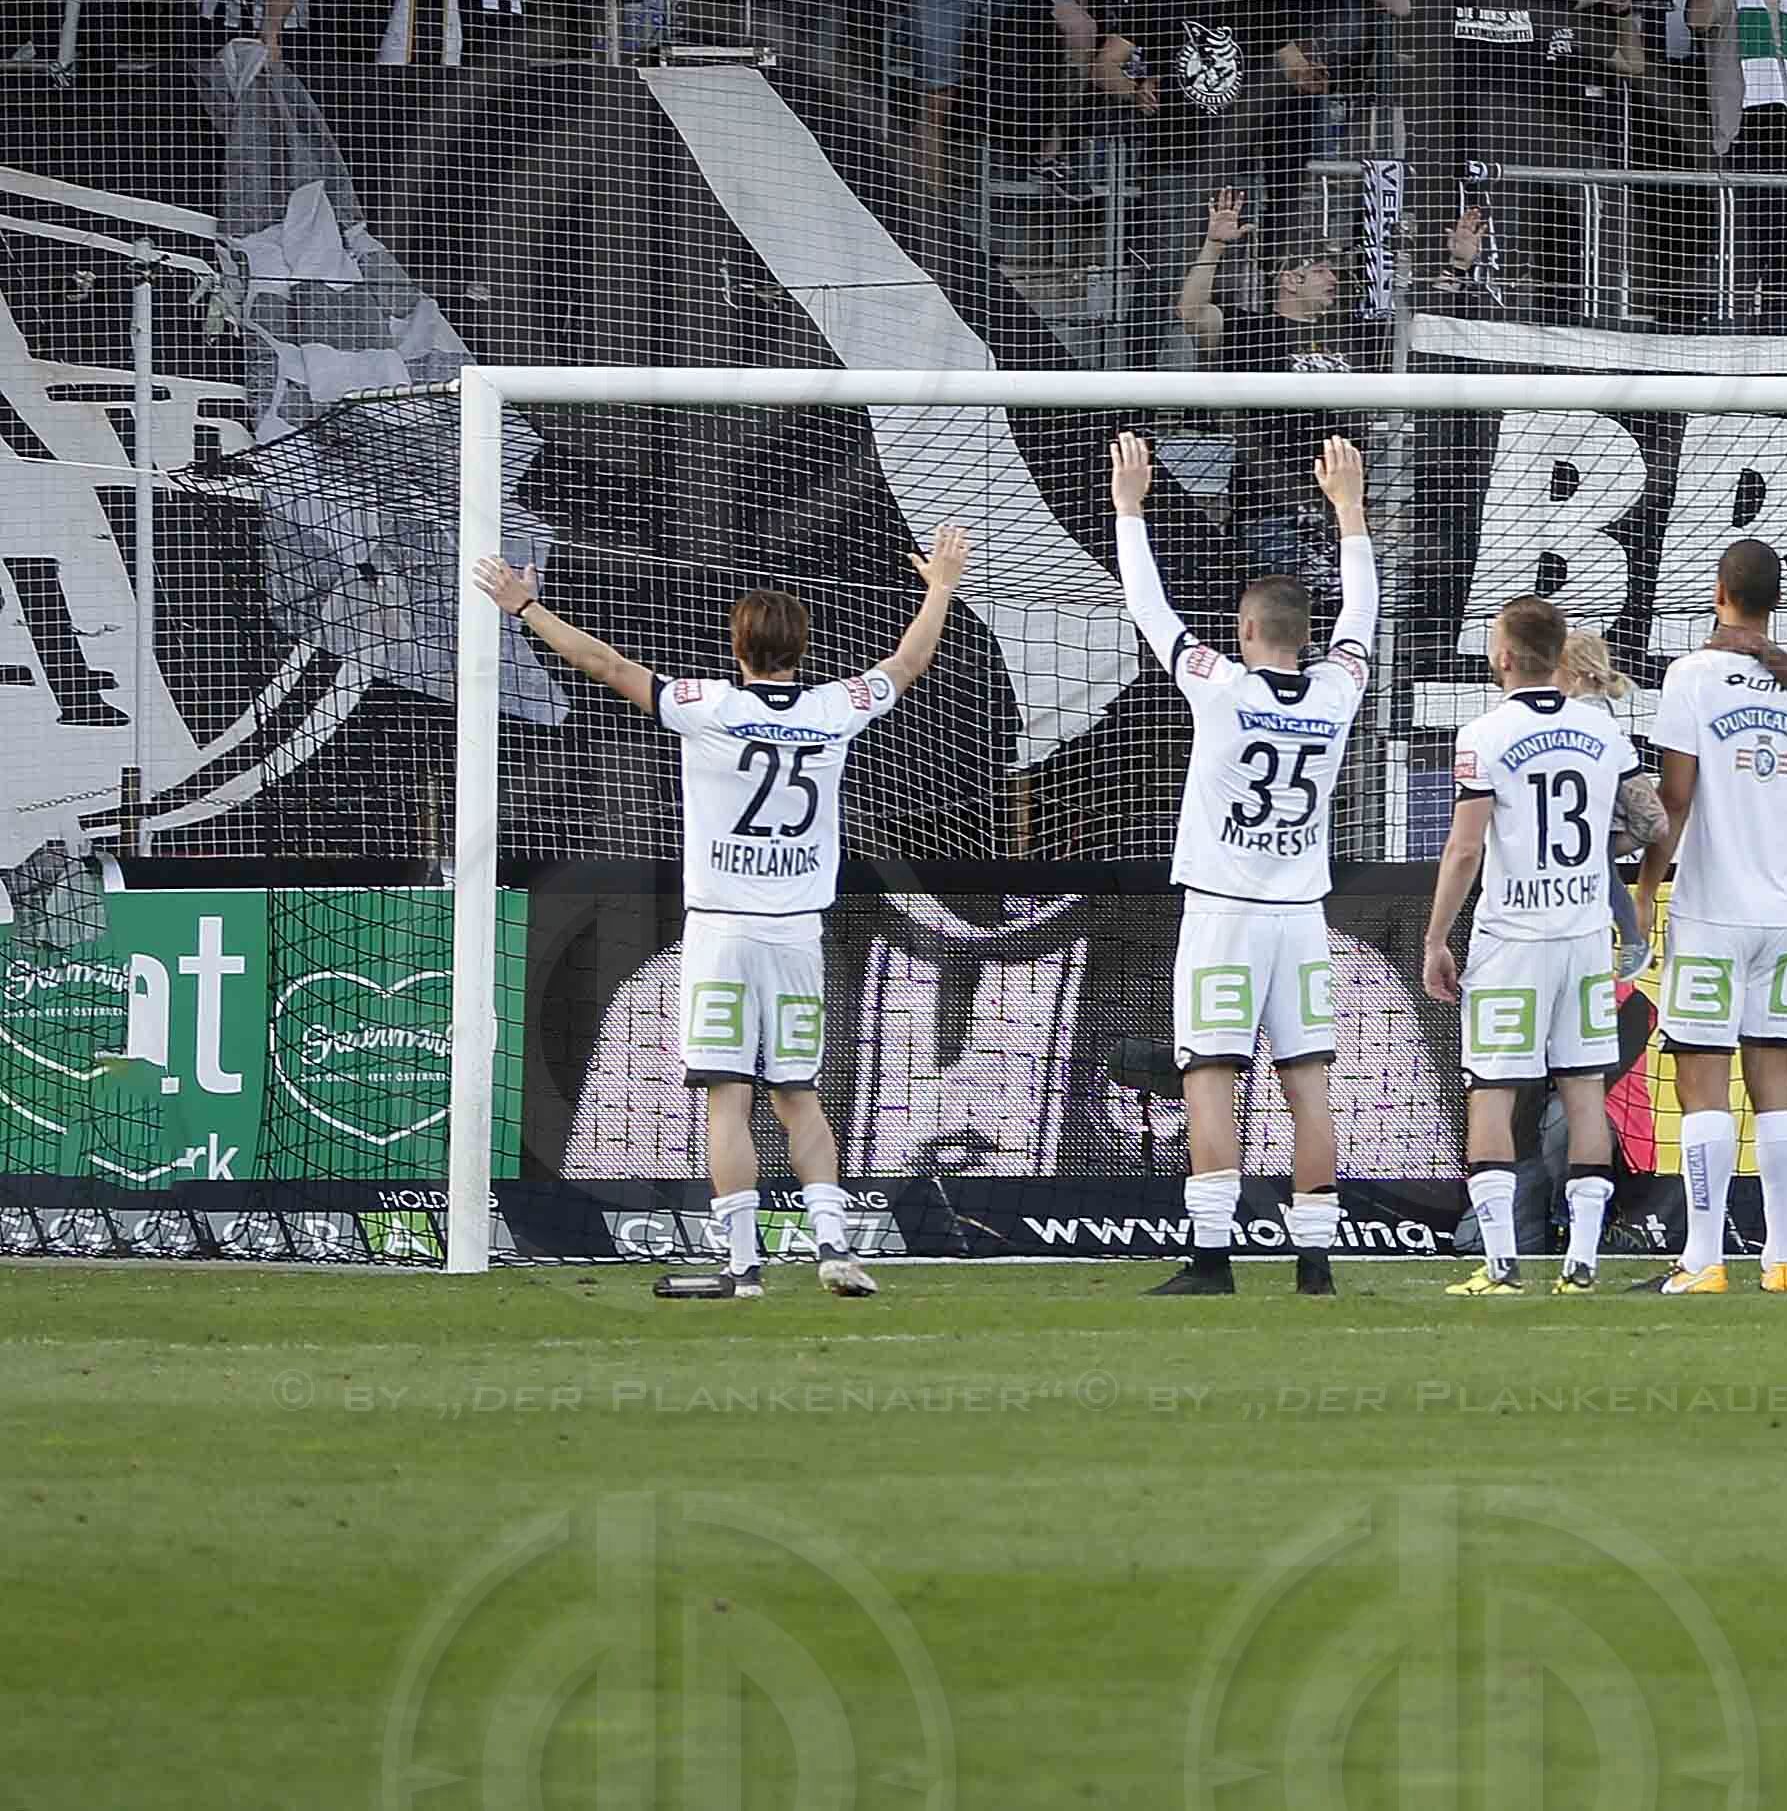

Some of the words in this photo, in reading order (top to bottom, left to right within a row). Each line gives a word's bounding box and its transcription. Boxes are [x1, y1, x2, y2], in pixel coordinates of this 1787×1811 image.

[730, 743, 825, 838] 25
[1231, 740, 1327, 829] 35
[1527, 769, 1593, 871] 13
[1502, 874, 1599, 910] JANTSCH
